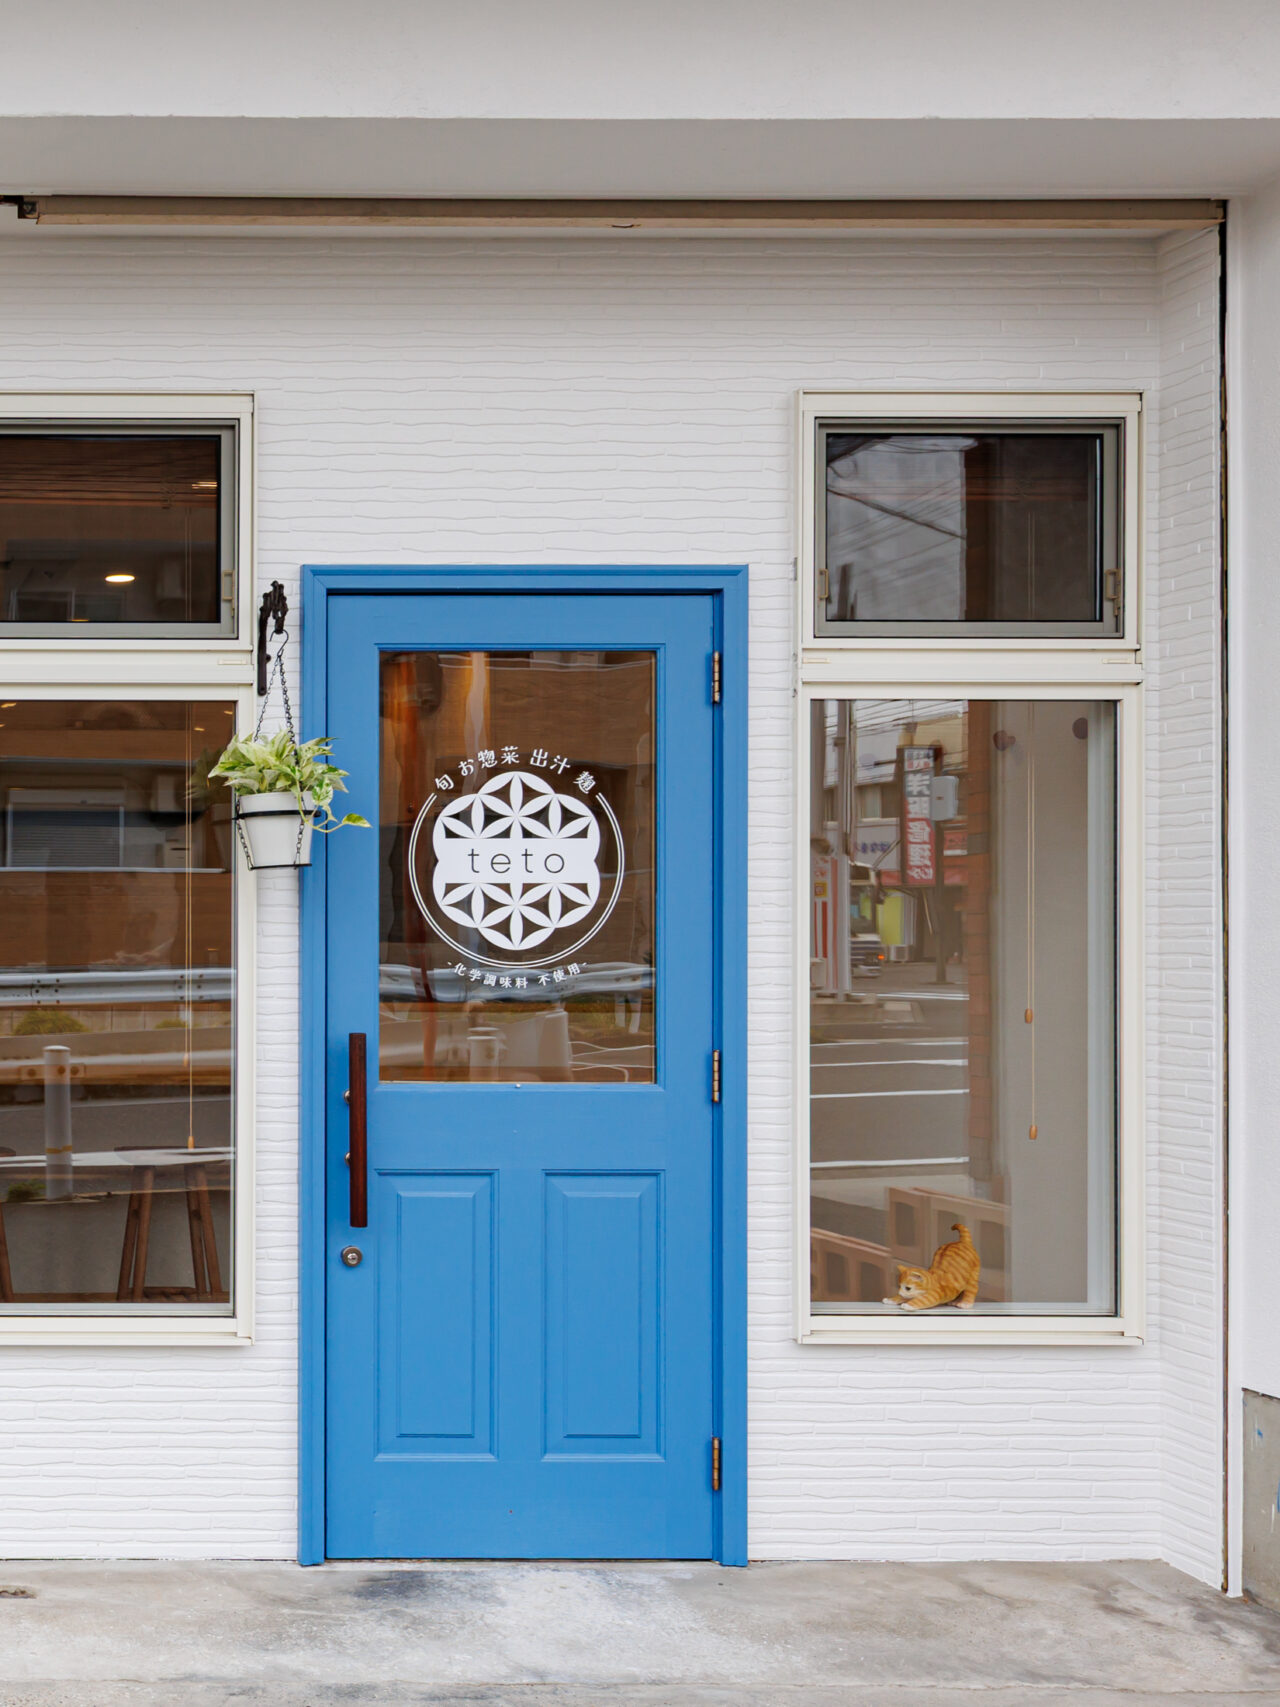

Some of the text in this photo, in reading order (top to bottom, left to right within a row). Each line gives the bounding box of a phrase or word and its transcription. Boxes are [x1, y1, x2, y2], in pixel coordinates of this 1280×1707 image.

[435, 773, 455, 791] 旬
[458, 746, 520, 776] お惣菜
[529, 748, 571, 775] 出汁
[468, 848, 565, 874] teto
